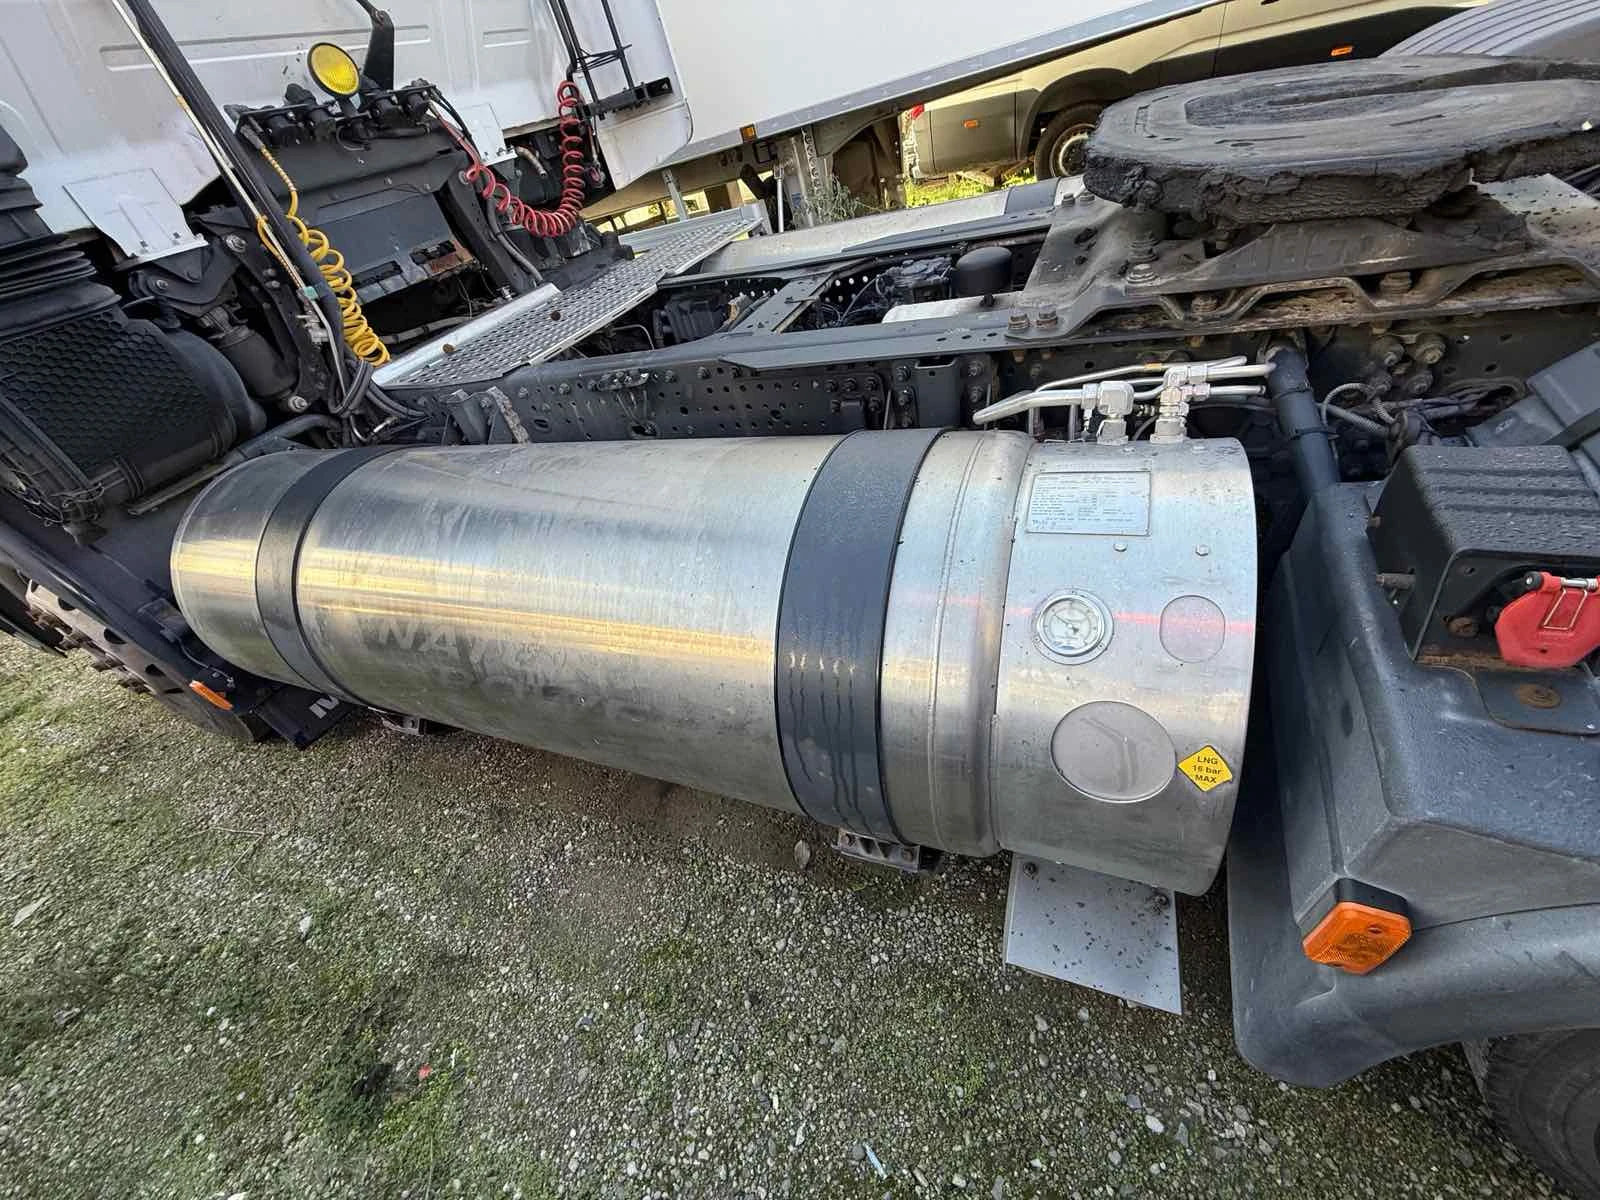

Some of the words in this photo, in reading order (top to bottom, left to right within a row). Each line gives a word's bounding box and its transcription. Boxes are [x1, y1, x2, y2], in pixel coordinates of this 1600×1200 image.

[1197, 756, 1218, 765] LNG
[1192, 764, 1203, 772] 16
[1206, 766, 1222, 775] bar
[1195, 774, 1217, 783] MAX
